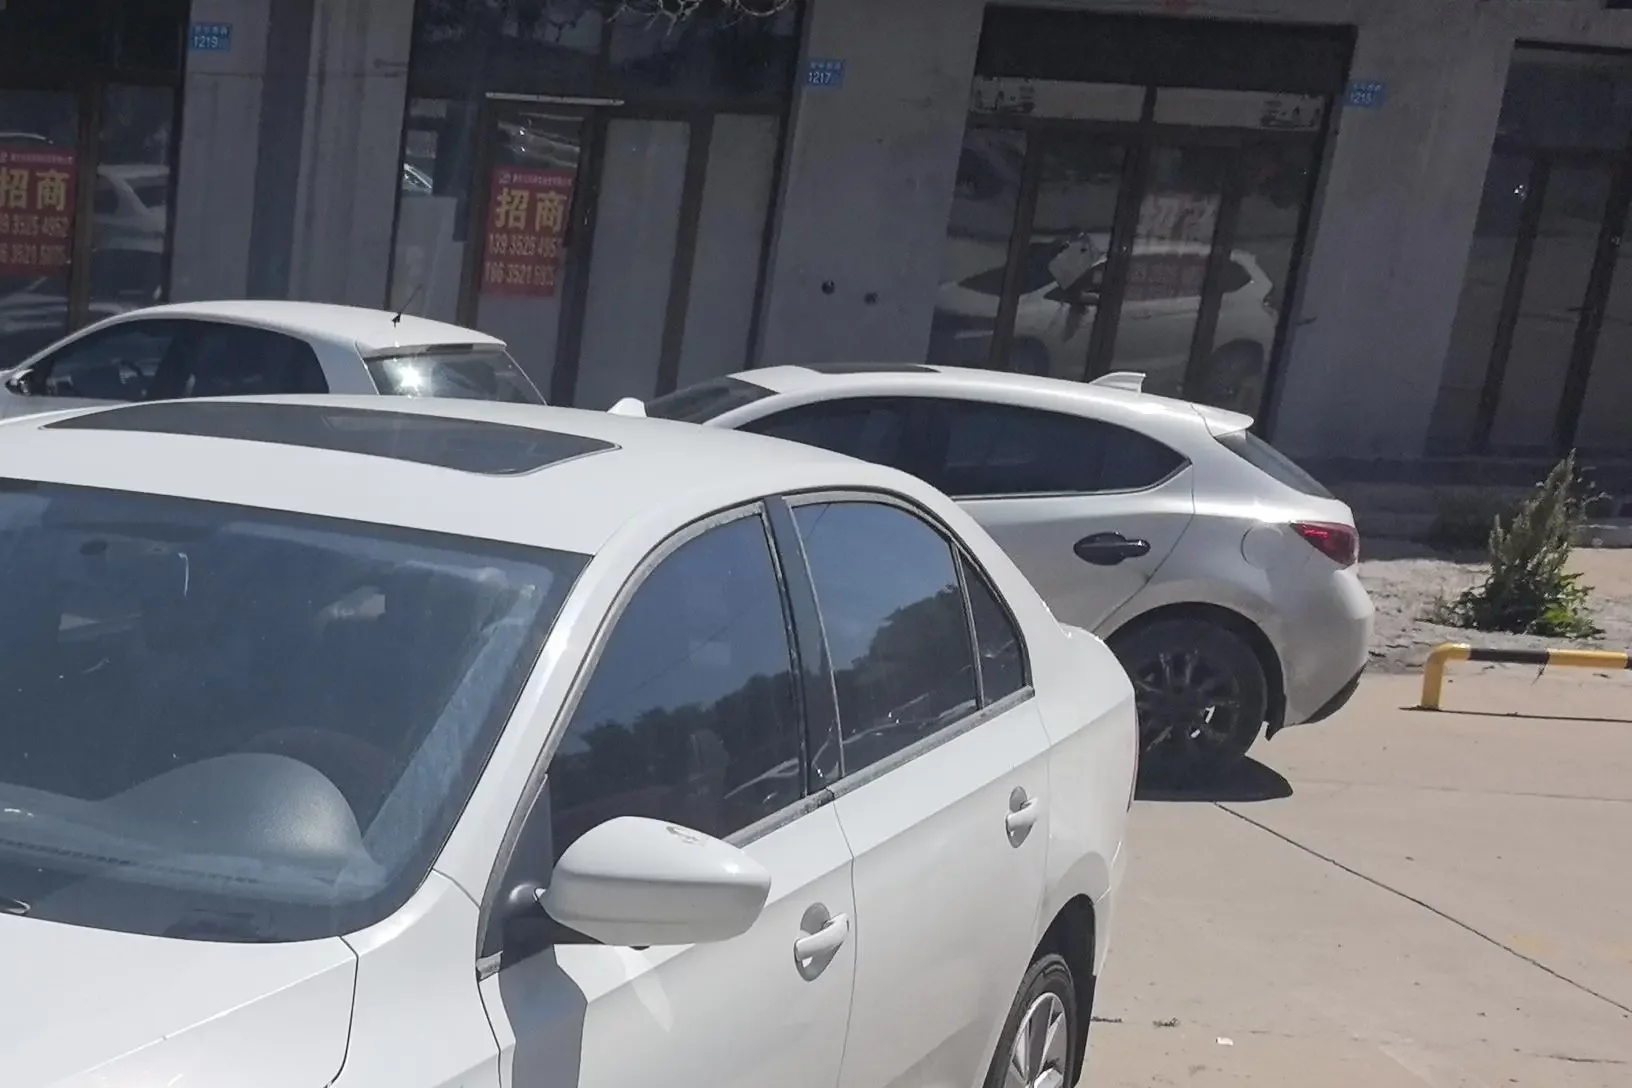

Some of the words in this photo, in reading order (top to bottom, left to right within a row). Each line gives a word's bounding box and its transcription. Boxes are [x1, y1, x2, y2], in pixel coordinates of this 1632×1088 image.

[194, 35, 218, 48] 1219
[808, 71, 831, 84] 1217
[495, 187, 567, 233] 招商
